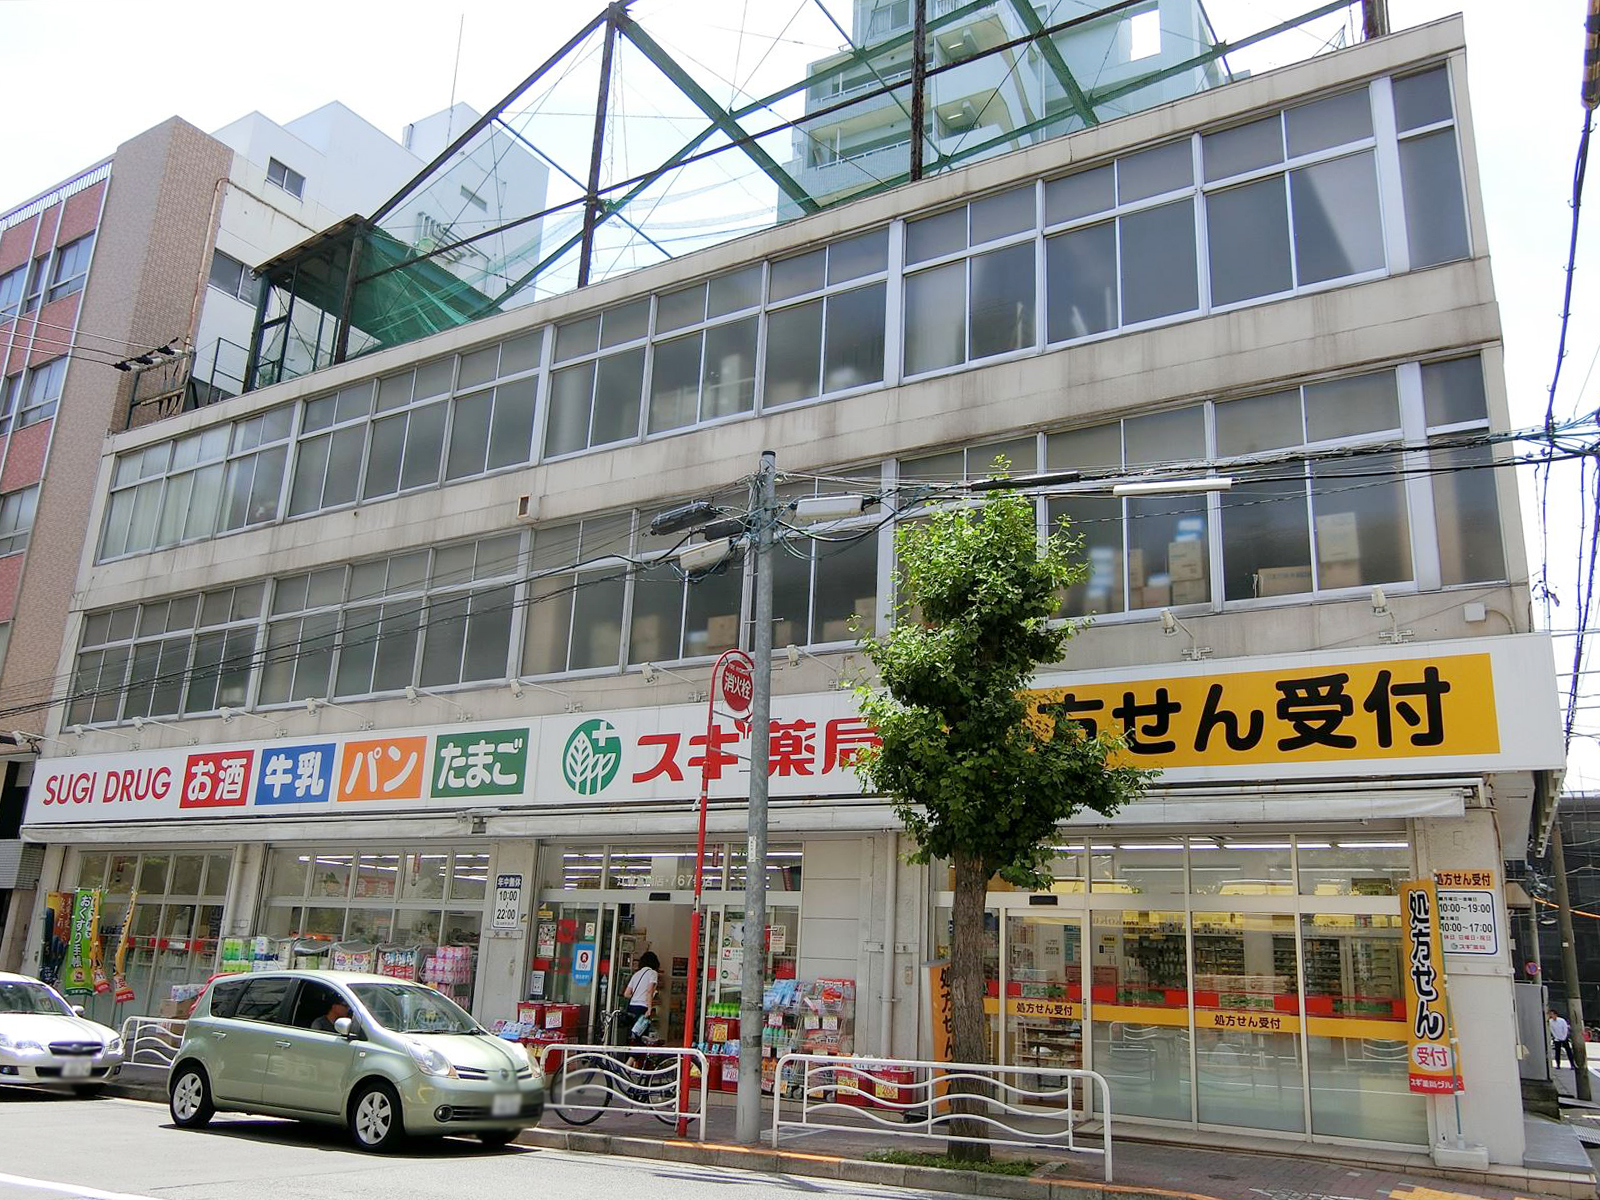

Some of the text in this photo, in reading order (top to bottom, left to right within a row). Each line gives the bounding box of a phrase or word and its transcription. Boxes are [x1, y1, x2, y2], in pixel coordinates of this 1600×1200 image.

[724, 671, 752, 700] 消火栓
[438, 738, 523, 789] たまご
[632, 718, 884, 784] スギ薬局
[188, 758, 248, 801] お酒
[264, 751, 324, 798] 牛乳
[345, 746, 417, 794] パン
[43, 766, 171, 805] SUGI DRUG
[497, 876, 522, 887] 年中無休
[1436, 872, 1491, 886] 処方せん受付
[500, 890, 518, 901] 10:00
[497, 909, 516, 920] 22:00
[1408, 890, 1444, 1040] 処方せん
[1016, 1002, 1073, 1016] 処方せん受付
[1214, 1014, 1281, 1029] 処方せん受付
[1416, 1047, 1448, 1067] 受付
